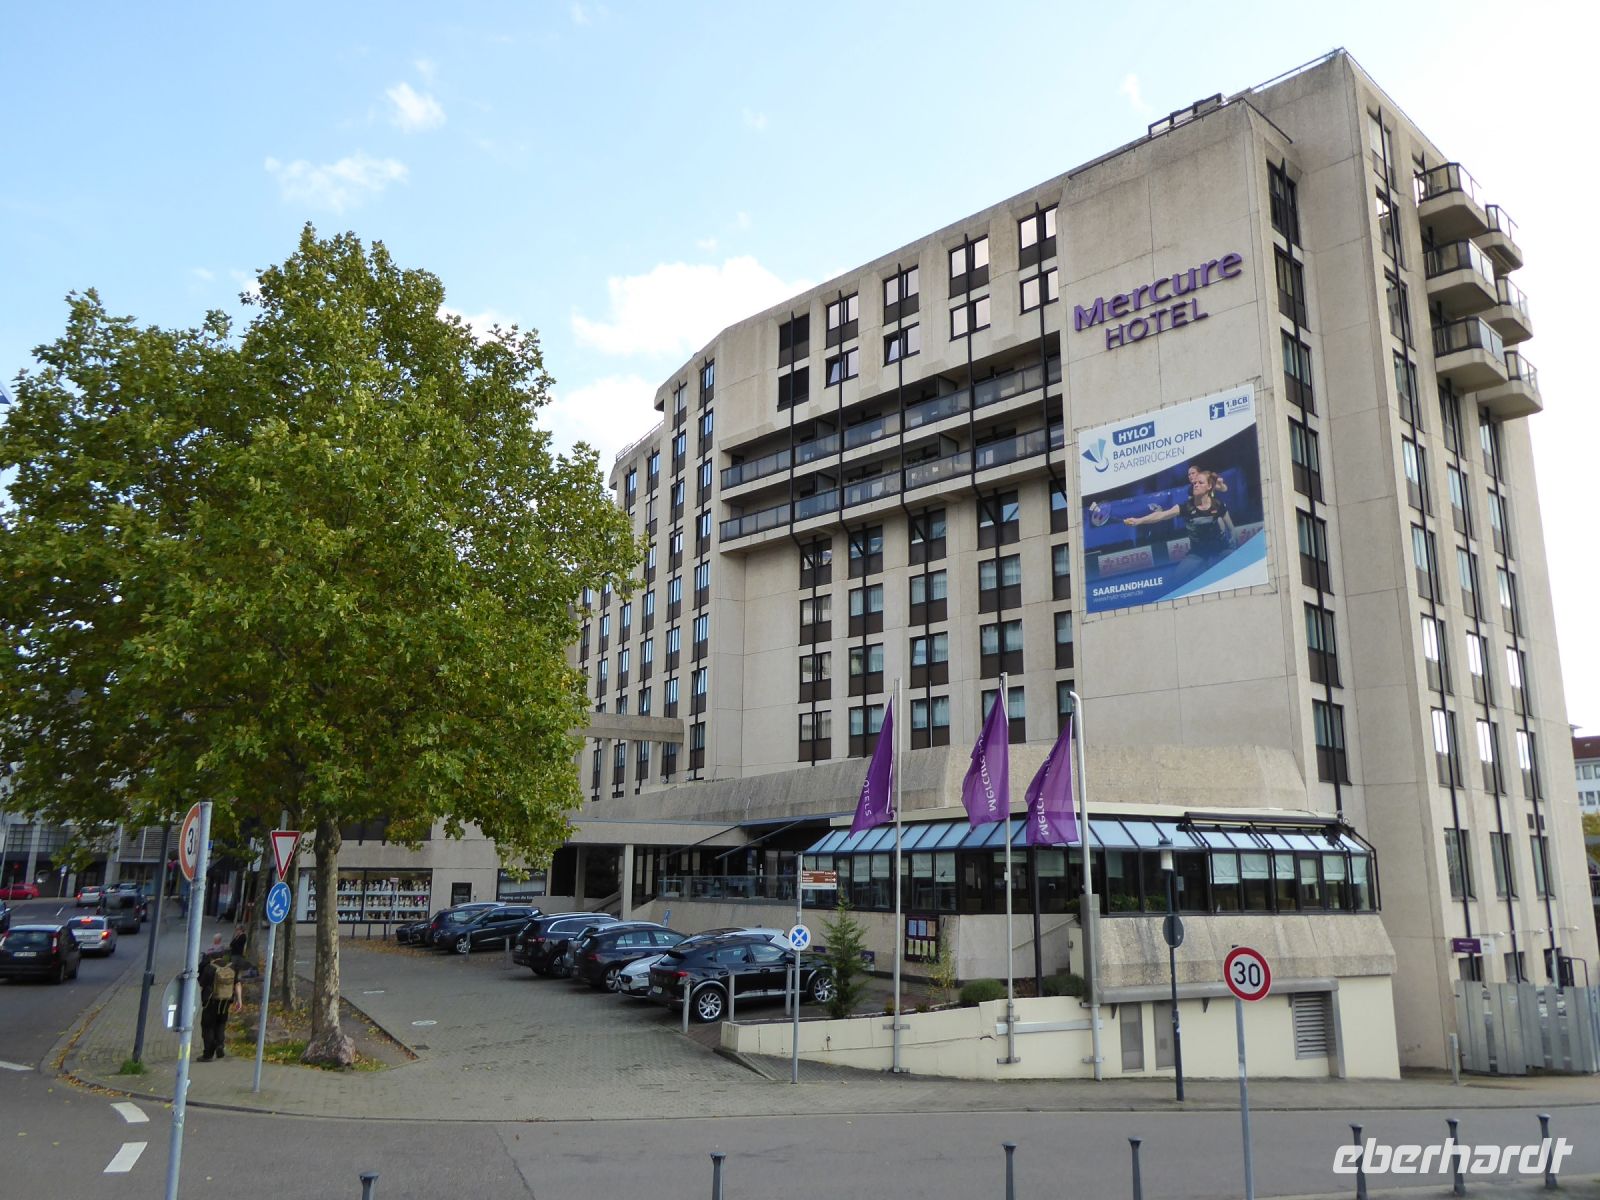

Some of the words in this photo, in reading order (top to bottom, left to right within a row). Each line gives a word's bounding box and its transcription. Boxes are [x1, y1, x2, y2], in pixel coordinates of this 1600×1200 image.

[1073, 252, 1243, 332] Mercure
[1105, 298, 1209, 350] HOTEL
[1113, 436, 1172, 460] BADMINTON
[1174, 428, 1203, 444] OPEN
[1113, 446, 1185, 472] SAARBRÜCKEN
[1092, 577, 1163, 597] SAARLANDHALLE
[863, 776, 872, 817] OTELS
[1234, 961, 1260, 987] 30
